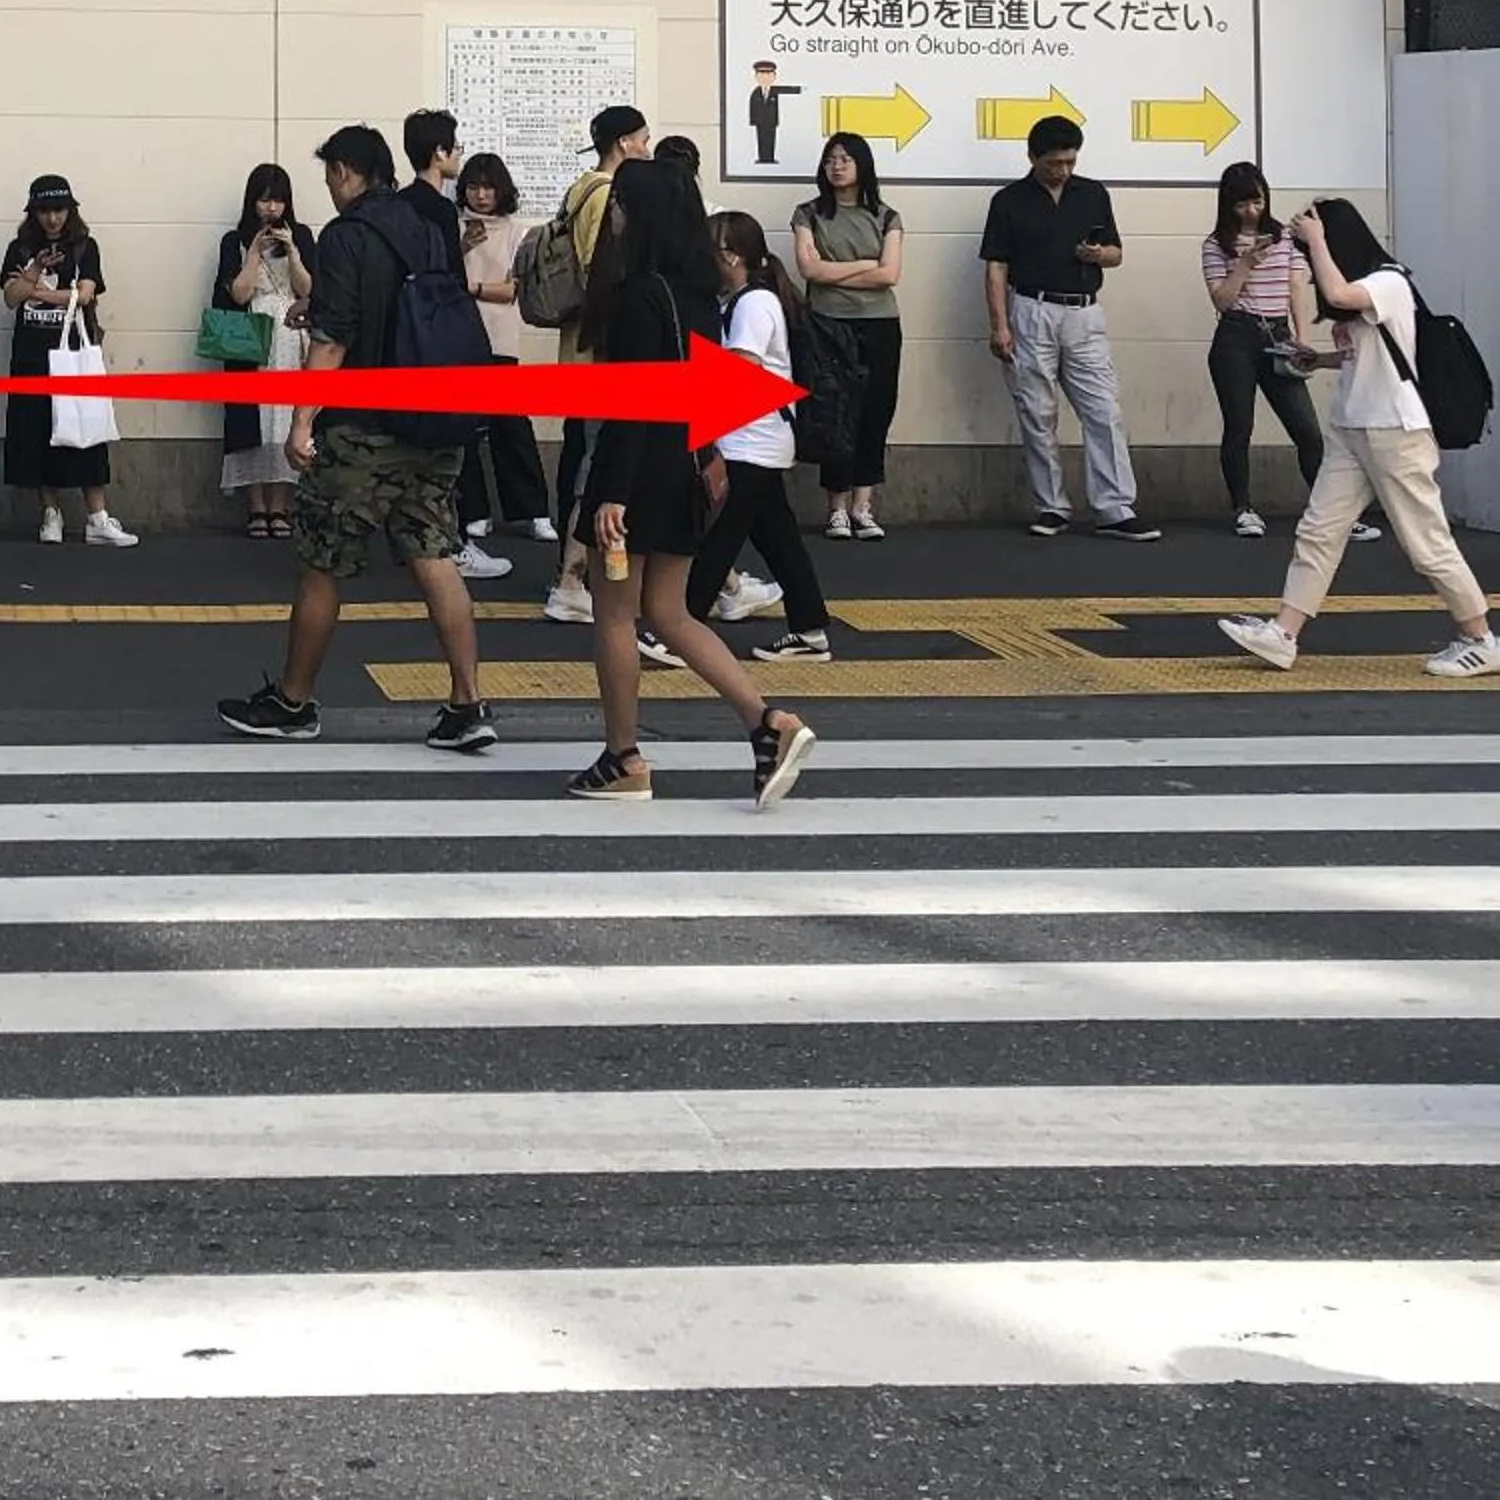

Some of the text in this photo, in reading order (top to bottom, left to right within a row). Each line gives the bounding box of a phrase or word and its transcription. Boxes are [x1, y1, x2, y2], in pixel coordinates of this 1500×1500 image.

[769, 33, 800, 54] Go
[805, 35, 880, 59] straight
[885, 39, 911, 55] on
[1031, 37, 1075, 57] Ave.
